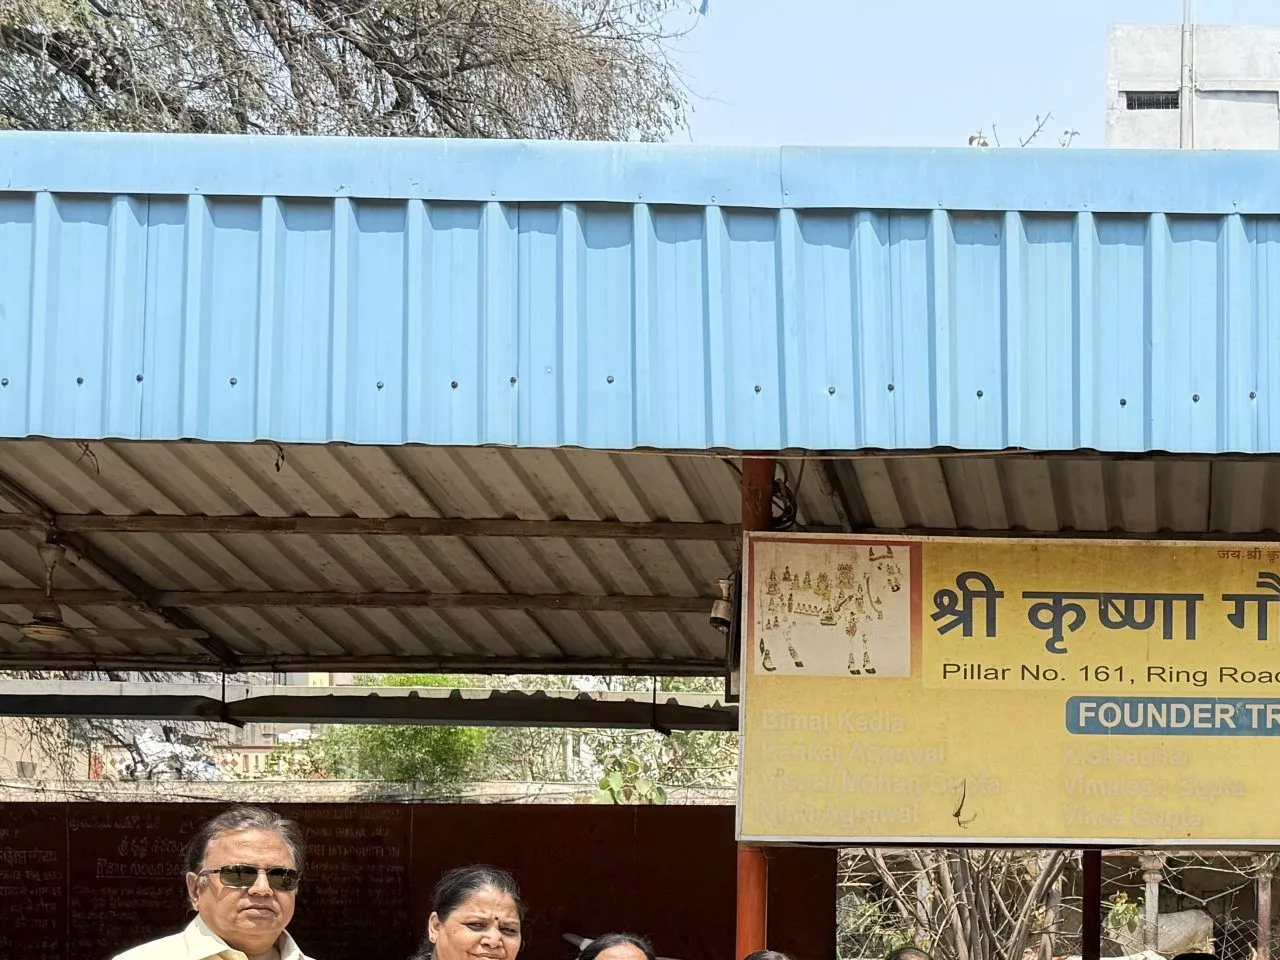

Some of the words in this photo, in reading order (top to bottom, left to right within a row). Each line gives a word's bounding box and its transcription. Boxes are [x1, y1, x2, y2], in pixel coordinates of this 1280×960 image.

[1217, 550, 1241, 561] जय
[1246, 547, 1262, 560] श्री
[930, 571, 1005, 638] श्री
[1022, 591, 1204, 655] कृष्णा
[942, 663, 1011, 681] Pillar
[1020, 664, 1066, 682] No.
[1078, 665, 1135, 685] 161,
[1146, 666, 1208, 687] Ring
[1078, 702, 1237, 729] FOUNDER
